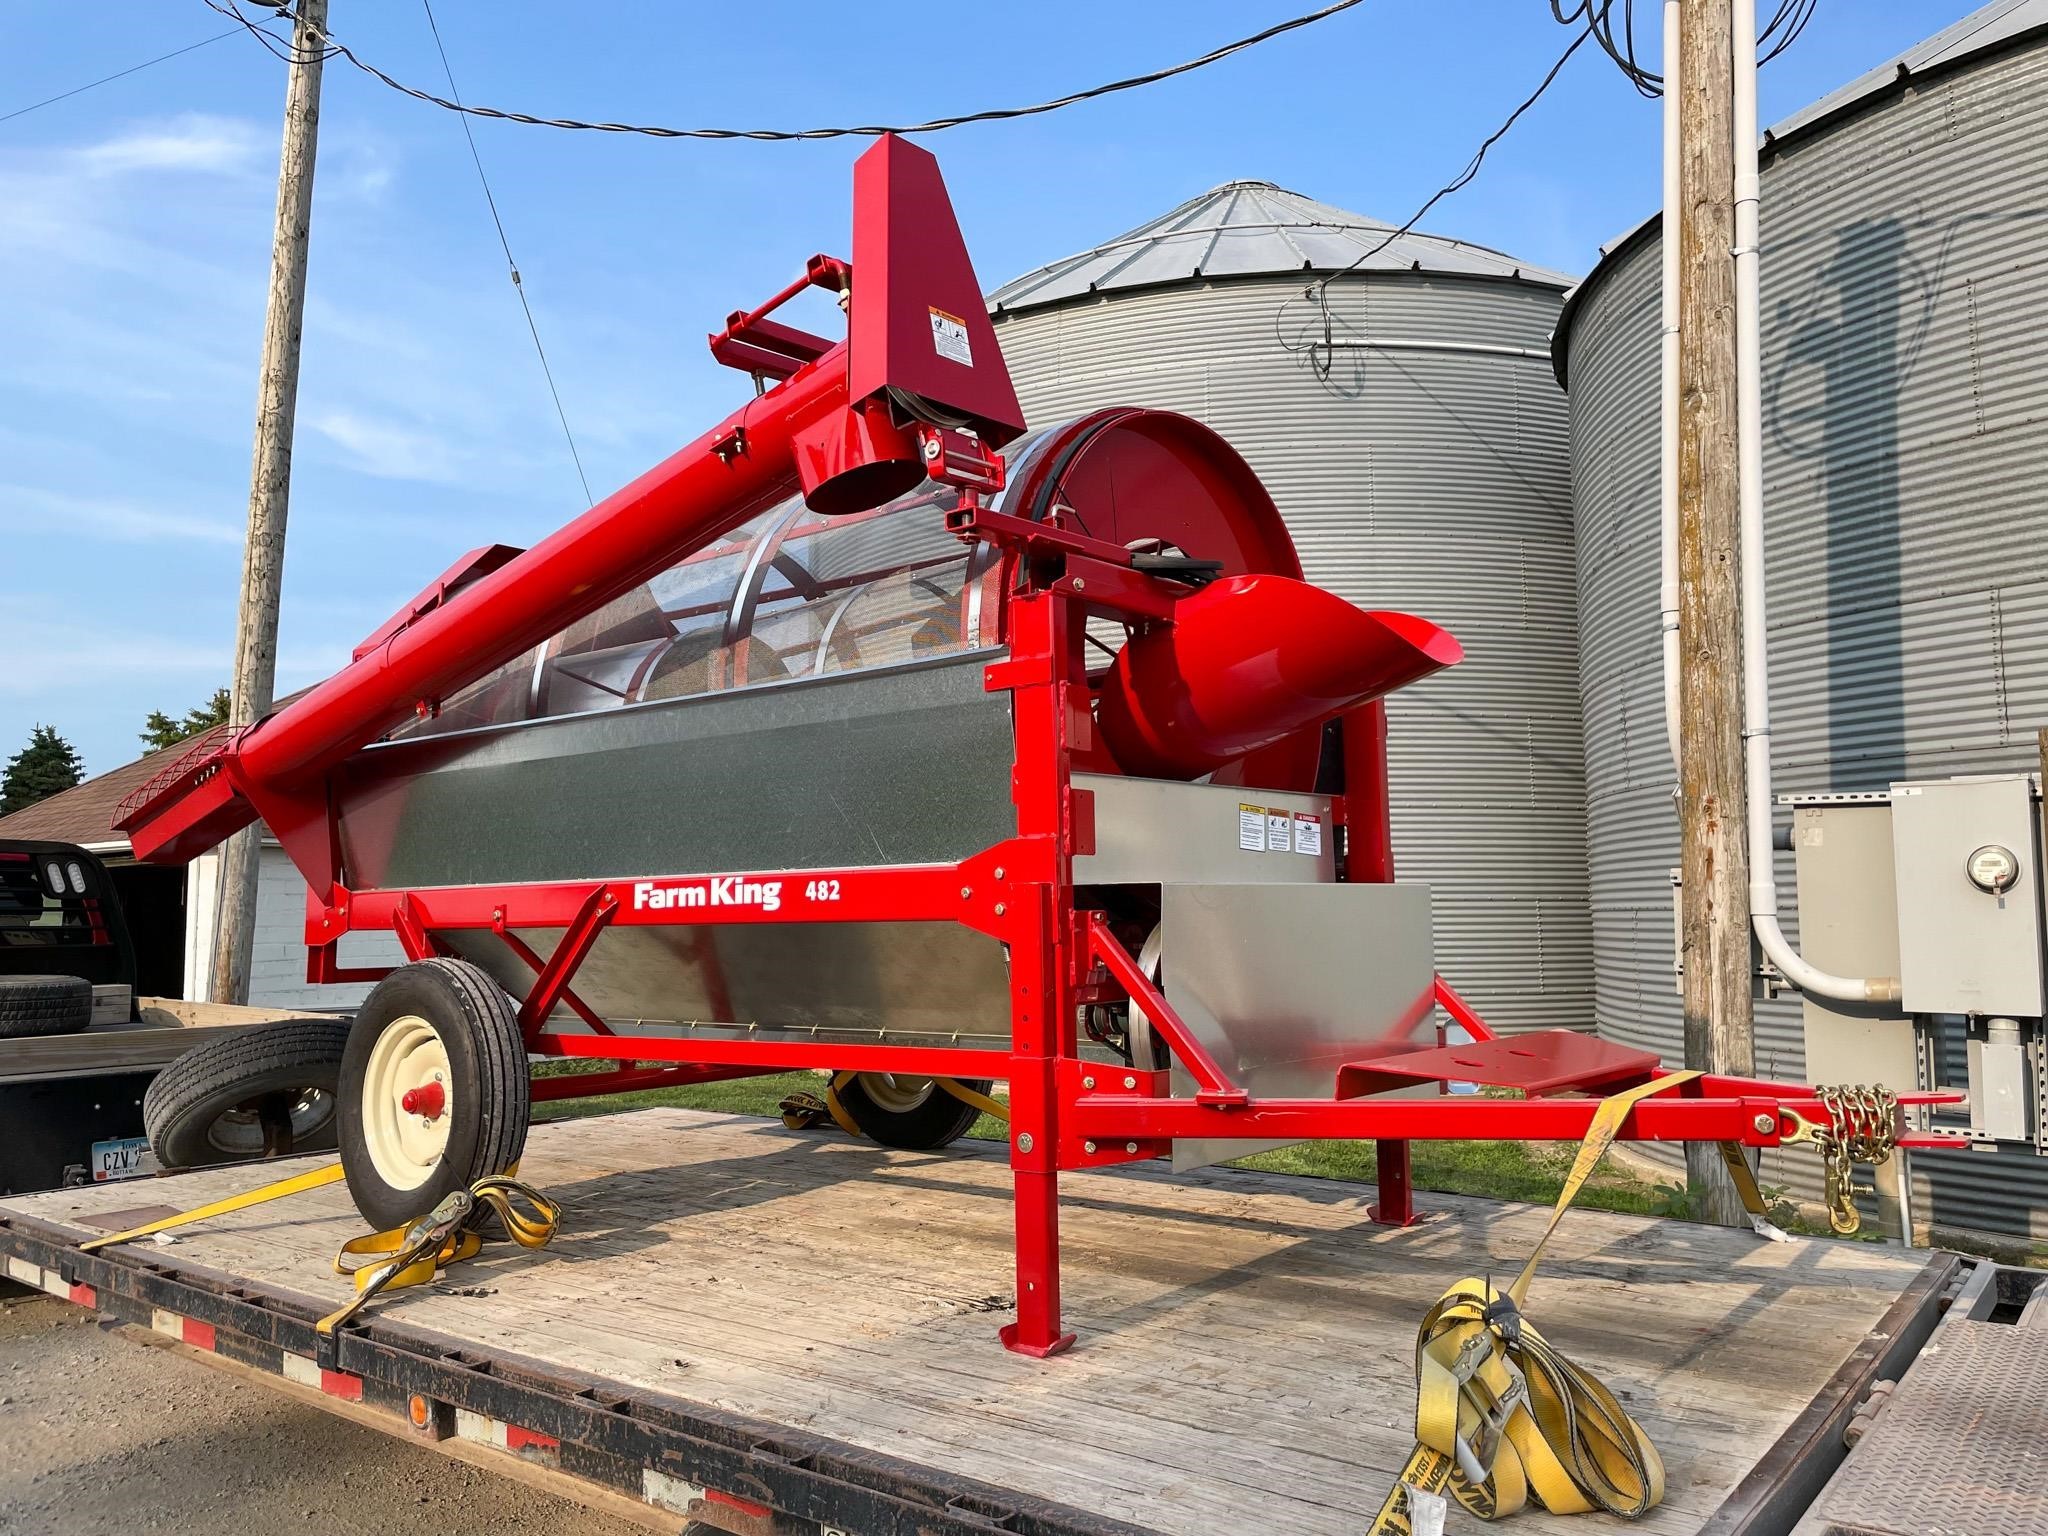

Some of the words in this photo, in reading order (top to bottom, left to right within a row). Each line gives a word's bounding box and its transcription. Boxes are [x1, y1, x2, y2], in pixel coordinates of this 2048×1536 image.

[634, 882, 706, 910] Farm
[710, 876, 782, 911] King
[805, 880, 840, 901] 482
[103, 1151, 128, 1170] CZV
